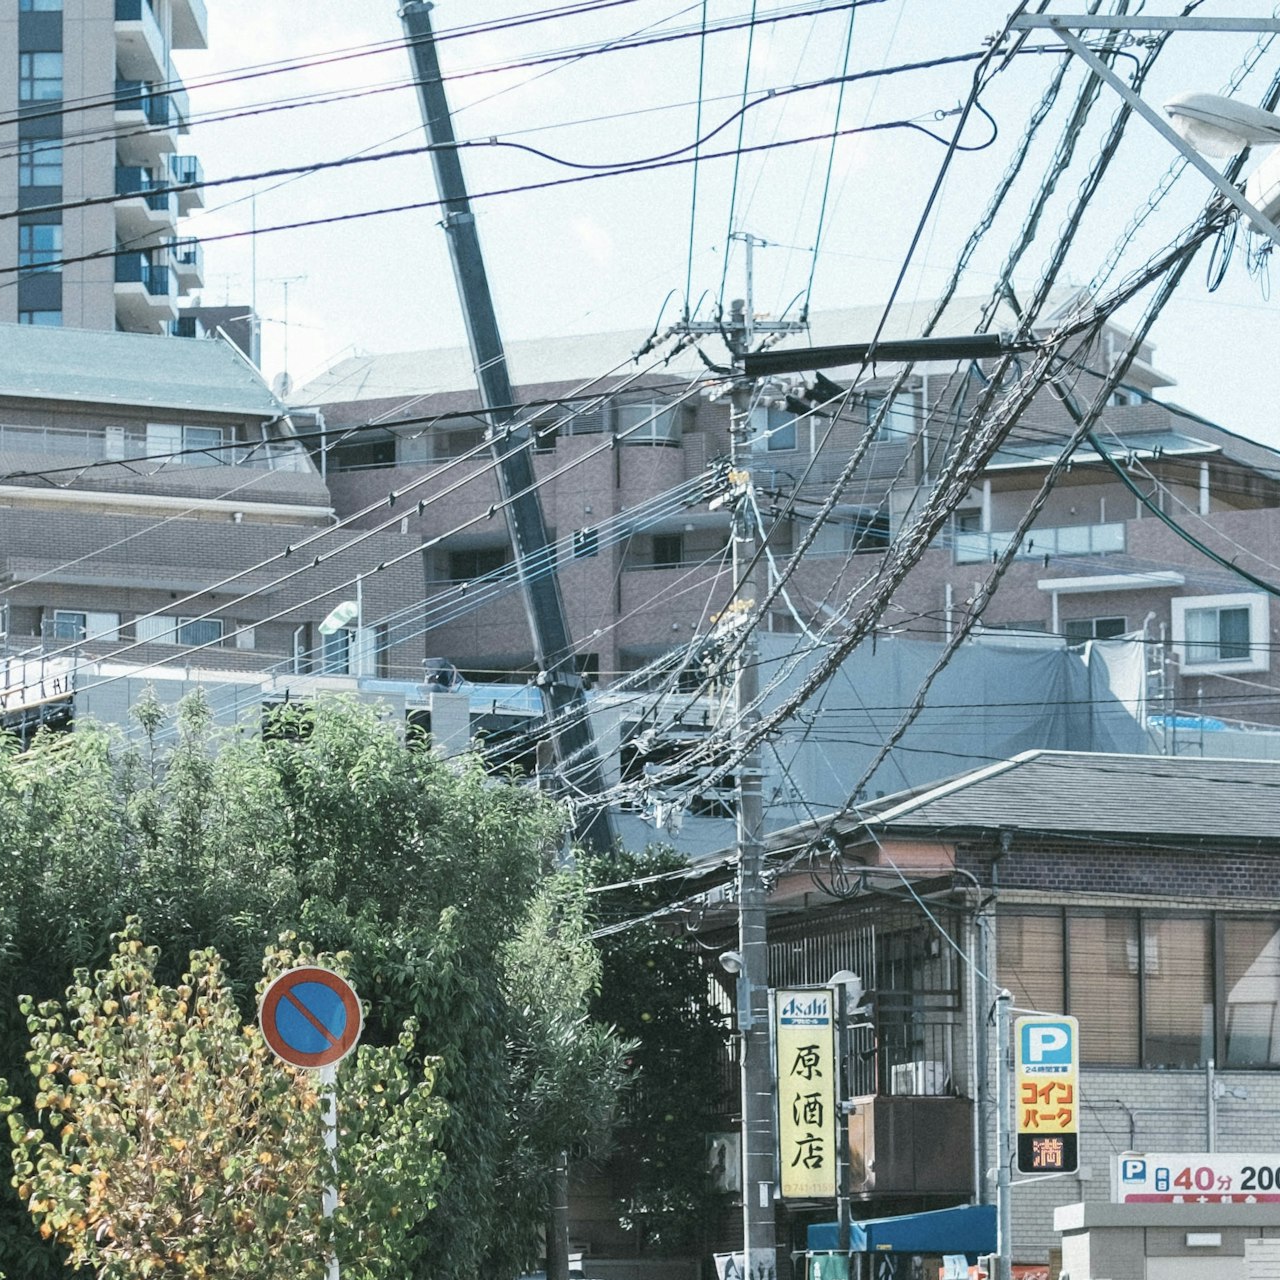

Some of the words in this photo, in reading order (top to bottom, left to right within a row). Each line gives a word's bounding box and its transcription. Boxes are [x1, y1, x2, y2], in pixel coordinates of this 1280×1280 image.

[782, 998, 827, 1016] Asahi
[1029, 1027, 1068, 1062] P
[1022, 1082, 1073, 1104] コイン
[790, 1044, 824, 1169] 原酒店
[1023, 1108, 1072, 1128] パーク
[1032, 1138, 1063, 1168] 満
[1126, 1161, 1143, 1178] P
